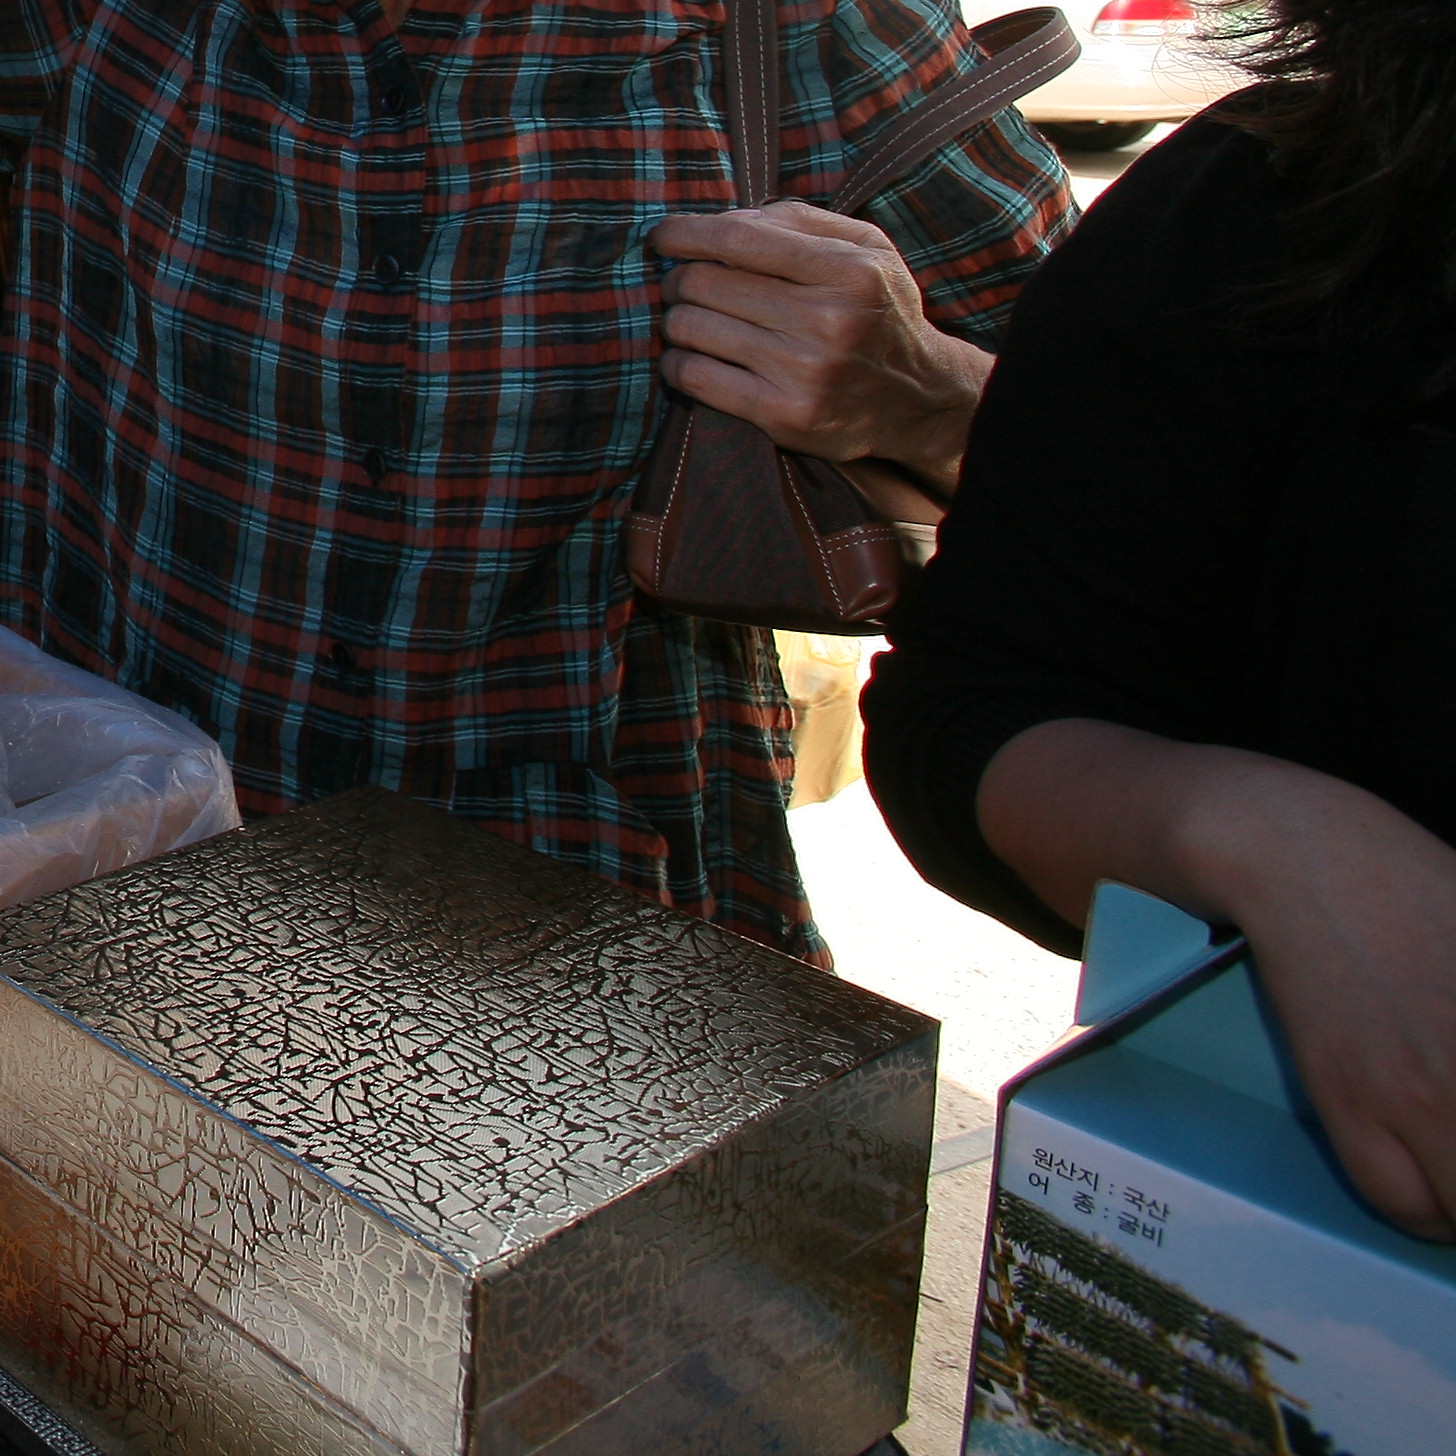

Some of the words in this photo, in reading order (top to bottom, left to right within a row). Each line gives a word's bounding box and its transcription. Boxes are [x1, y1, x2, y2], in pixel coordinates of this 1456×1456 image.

[1027, 1171, 1050, 1196] 어
[1071, 1190, 1096, 1215] 종
[1116, 1210, 1165, 1248] 굴비
[1032, 1147, 1099, 1192] 원산지
[1122, 1185, 1171, 1223] 국산
